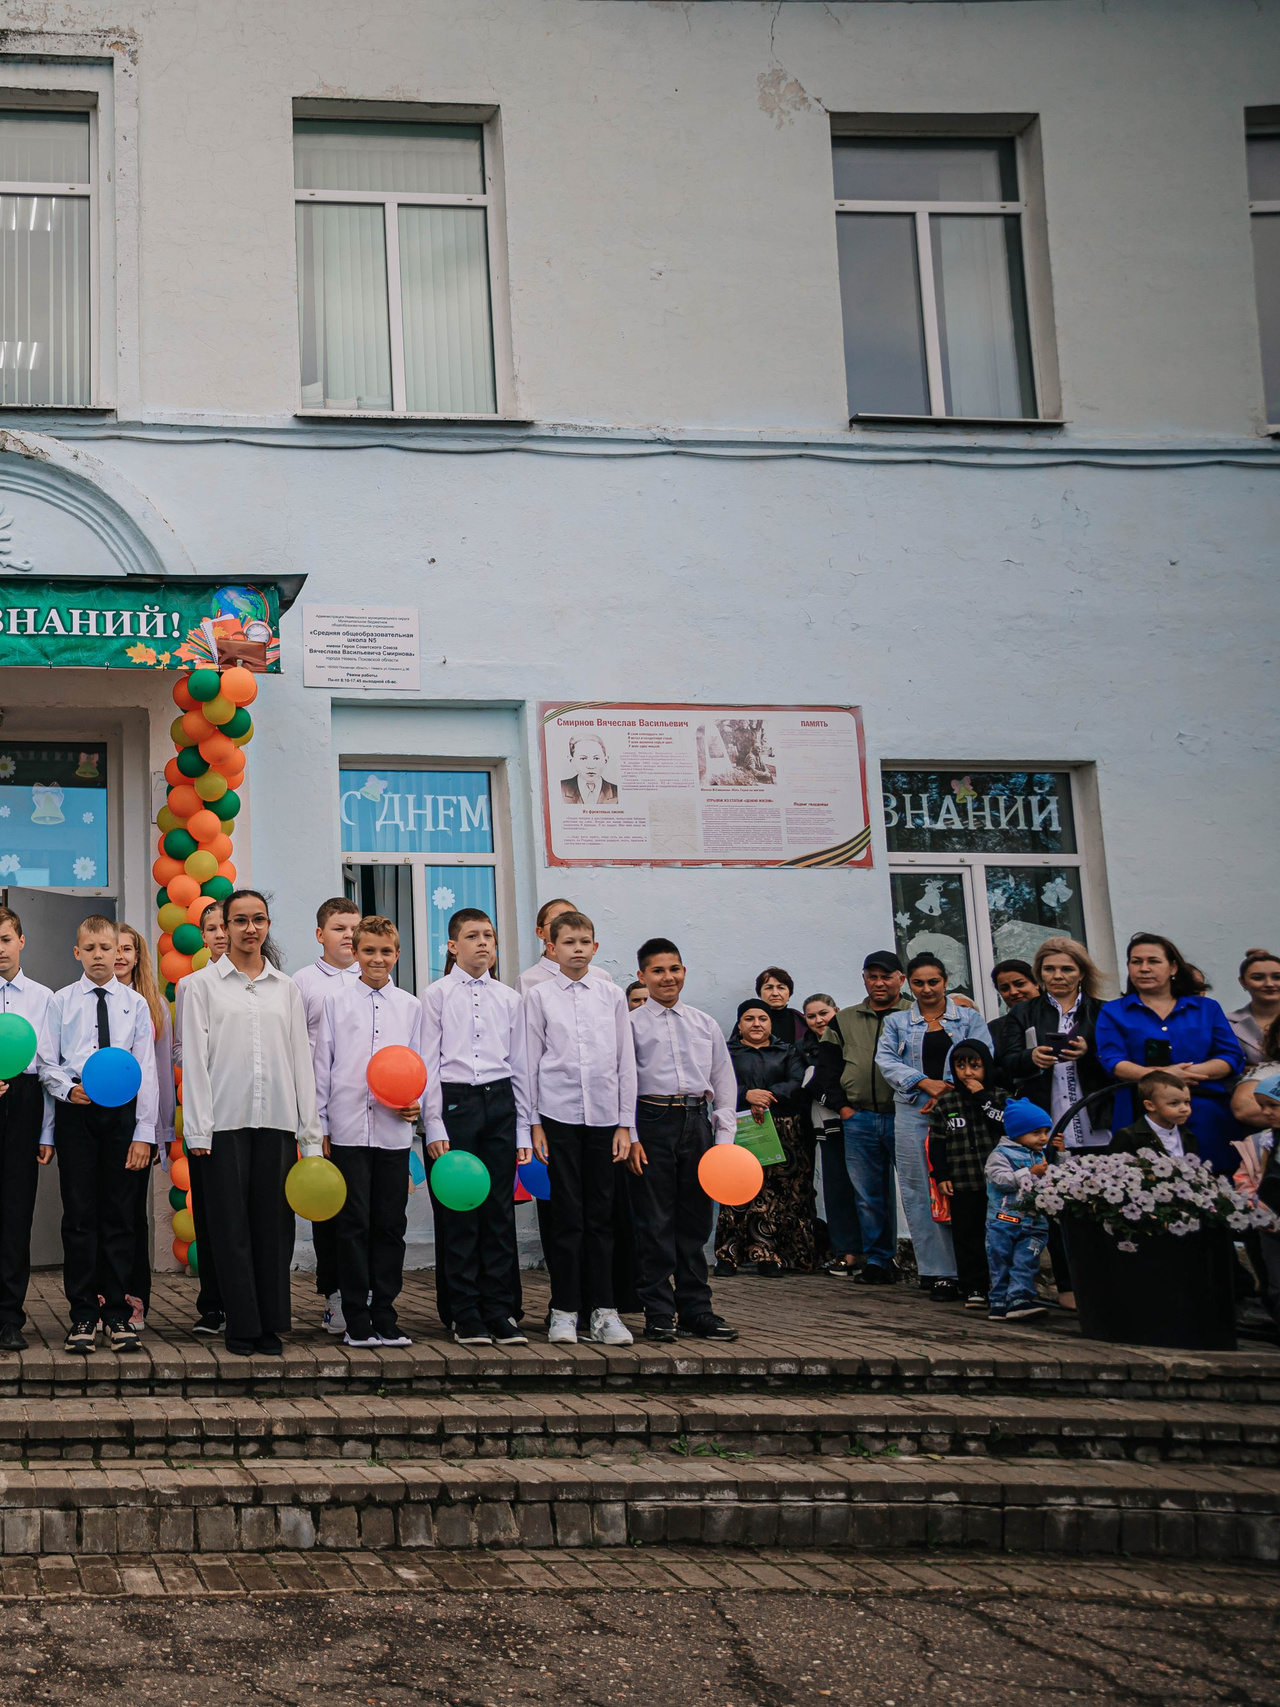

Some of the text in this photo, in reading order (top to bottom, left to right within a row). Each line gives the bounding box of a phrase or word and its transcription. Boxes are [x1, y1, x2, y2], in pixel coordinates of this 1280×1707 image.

[342, 630, 414, 638] общеобразовательная
[556, 717, 689, 728] Смирнов Вячеслав Васильевич
[800, 720, 829, 728] ПАМЯТЬ
[340, 790, 490, 833] С ДНЕМ
